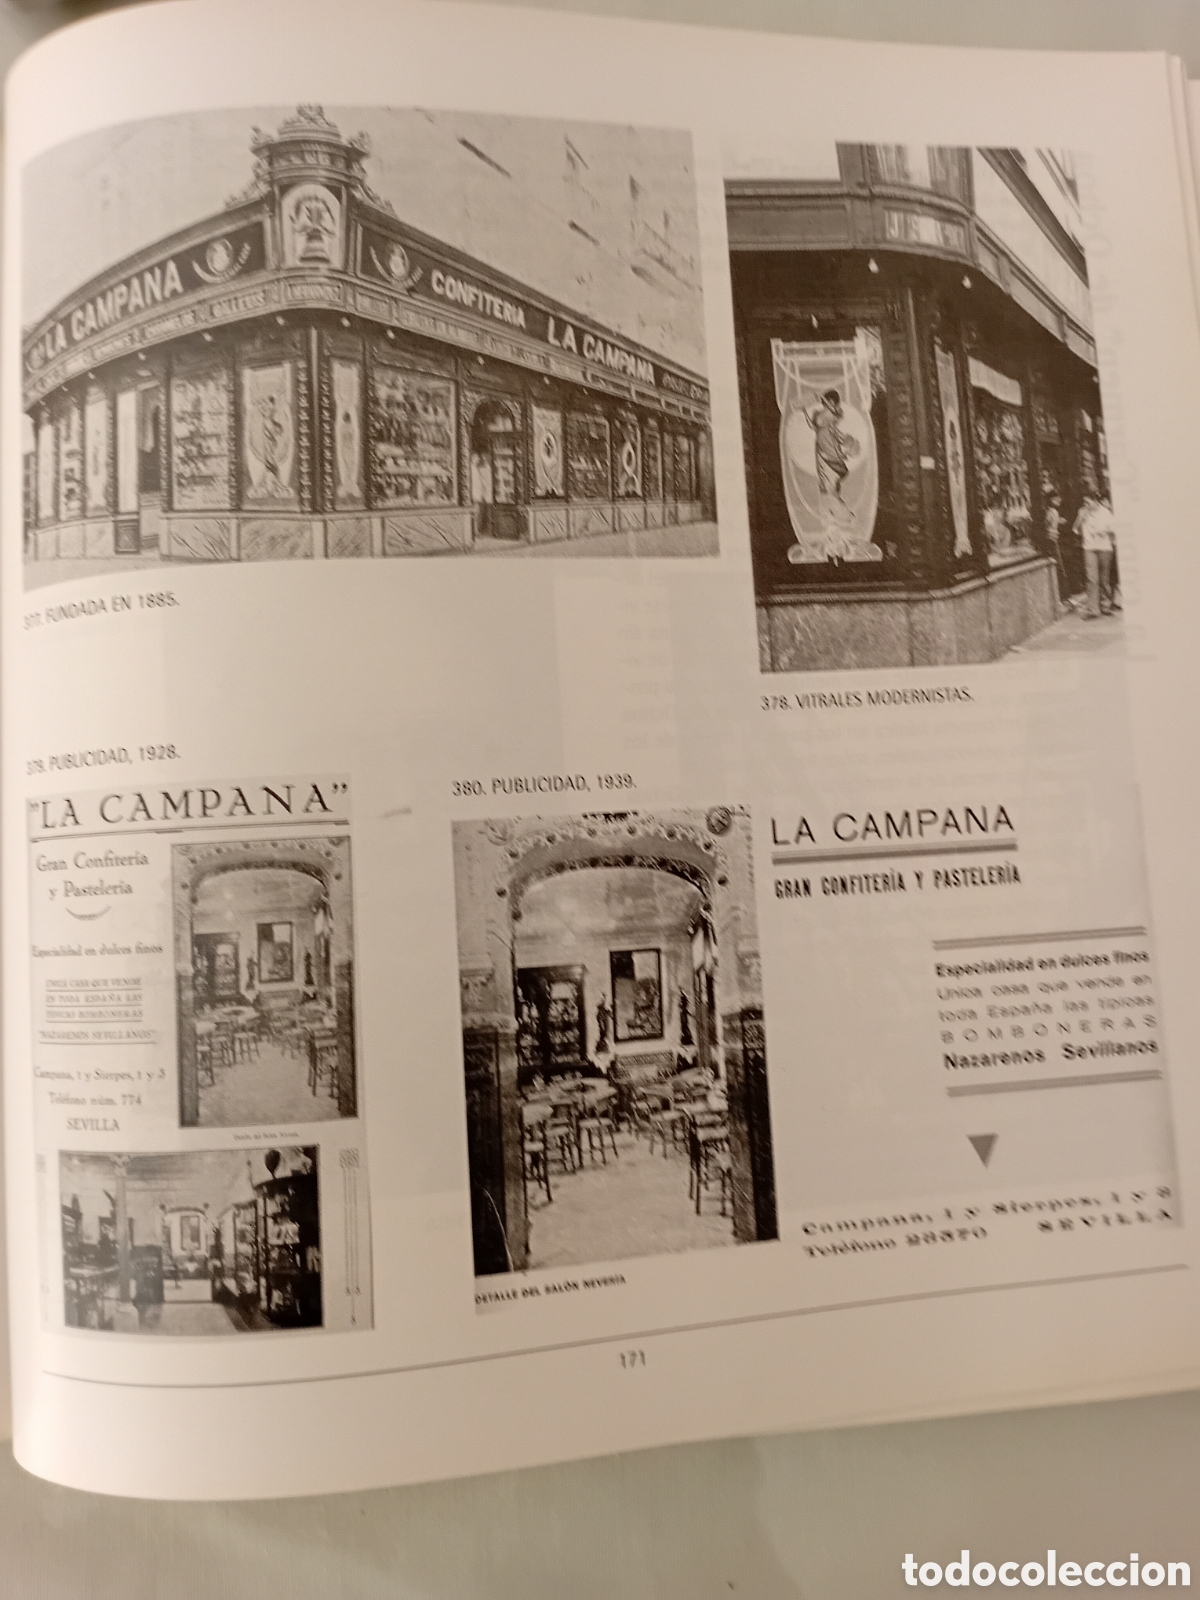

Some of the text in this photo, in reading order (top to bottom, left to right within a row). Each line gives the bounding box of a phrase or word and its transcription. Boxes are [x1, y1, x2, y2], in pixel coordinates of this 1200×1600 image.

[44, 323, 68, 356] LA
[70, 259, 184, 342] CAMPANA
[431, 270, 526, 329] CONFITERIA
[547, 316, 577, 354] LA
[583, 333, 655, 385] CAMPANA
[45, 598, 108, 623] FUNDADA
[111, 594, 132, 612] EN
[137, 590, 180, 609] 1885.
[761, 686, 975, 711] 378. VITRALES MODERNISTAS.
[49, 747, 132, 770] PUBLICIDAD,
[138, 743, 181, 761] 1928.
[451, 773, 637, 796] 380. PUBLICIDAD, 1939.
[771, 804, 1015, 845] LA CAMPANA
[36, 849, 150, 872] Gran Confitería
[48, 879, 133, 901] y Pastelería
[774, 877, 812, 899] GRAN
[914, 870, 925, 890] Y
[84, 947, 97, 956] en
[99, 941, 133, 956] dulces
[134, 940, 163, 954] finos
[934, 950, 1150, 979] Especialidad en dulces finos
[990, 983, 1030, 998] casa
[1036, 980, 1070, 995] que
[1075, 975, 1125, 990] vende
[1131, 973, 1153, 986] en
[938, 1008, 978, 1023] toda
[1062, 999, 1090, 1012] las
[942, 1039, 1160, 1071] Nazarenos Sevillanos
[146, 1070, 154, 1081] y
[66, 1117, 121, 1132] SEVILLA
[1037, 1208, 1173, 1234] SEVILLA
[475, 1288, 518, 1305] DETALLE
[521, 1285, 541, 1299] DEL
[620, 1350, 647, 1369] 171
